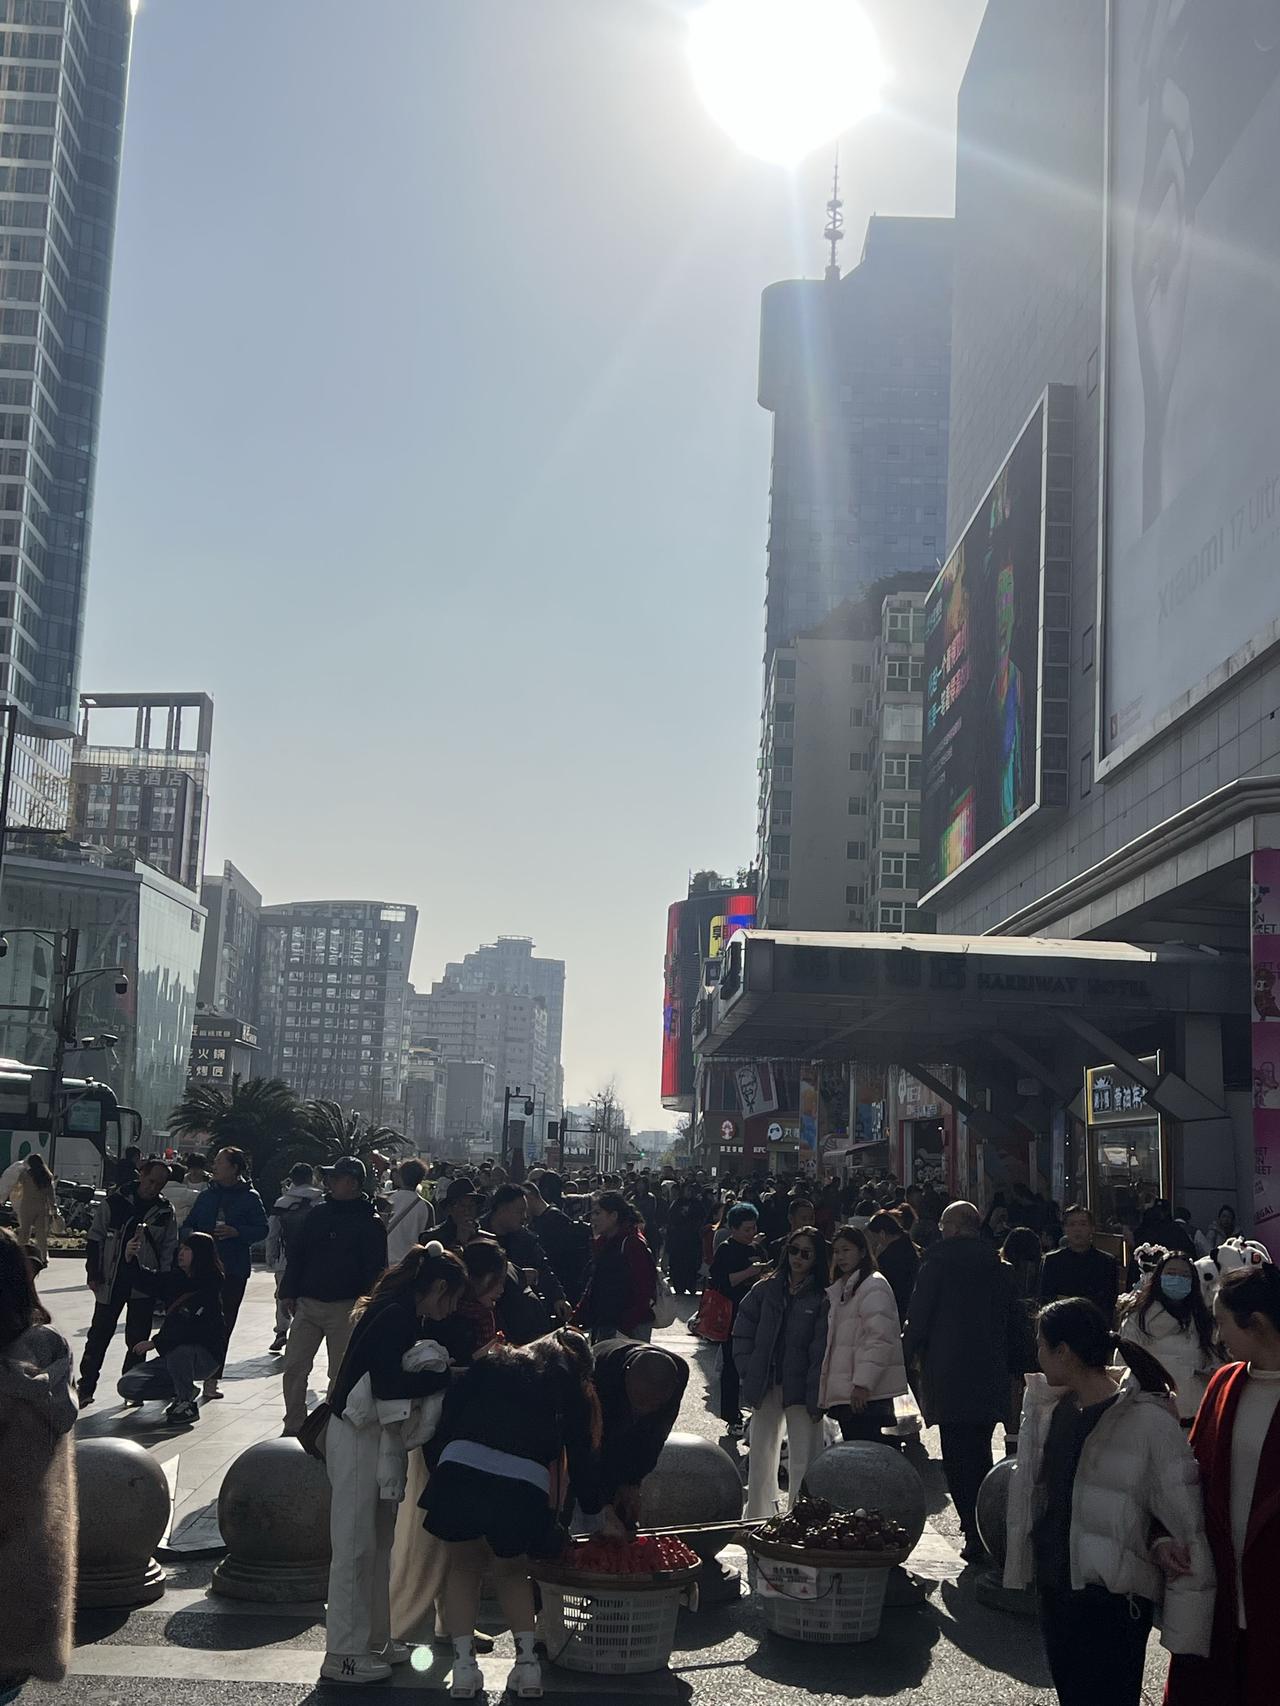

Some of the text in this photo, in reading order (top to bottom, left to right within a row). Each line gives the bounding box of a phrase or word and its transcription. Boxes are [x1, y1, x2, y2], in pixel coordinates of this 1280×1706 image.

[1230, 505, 1245, 552] 17
[1248, 473, 1280, 534] Ultr
[101, 767, 183, 786] 凯宾酒店
